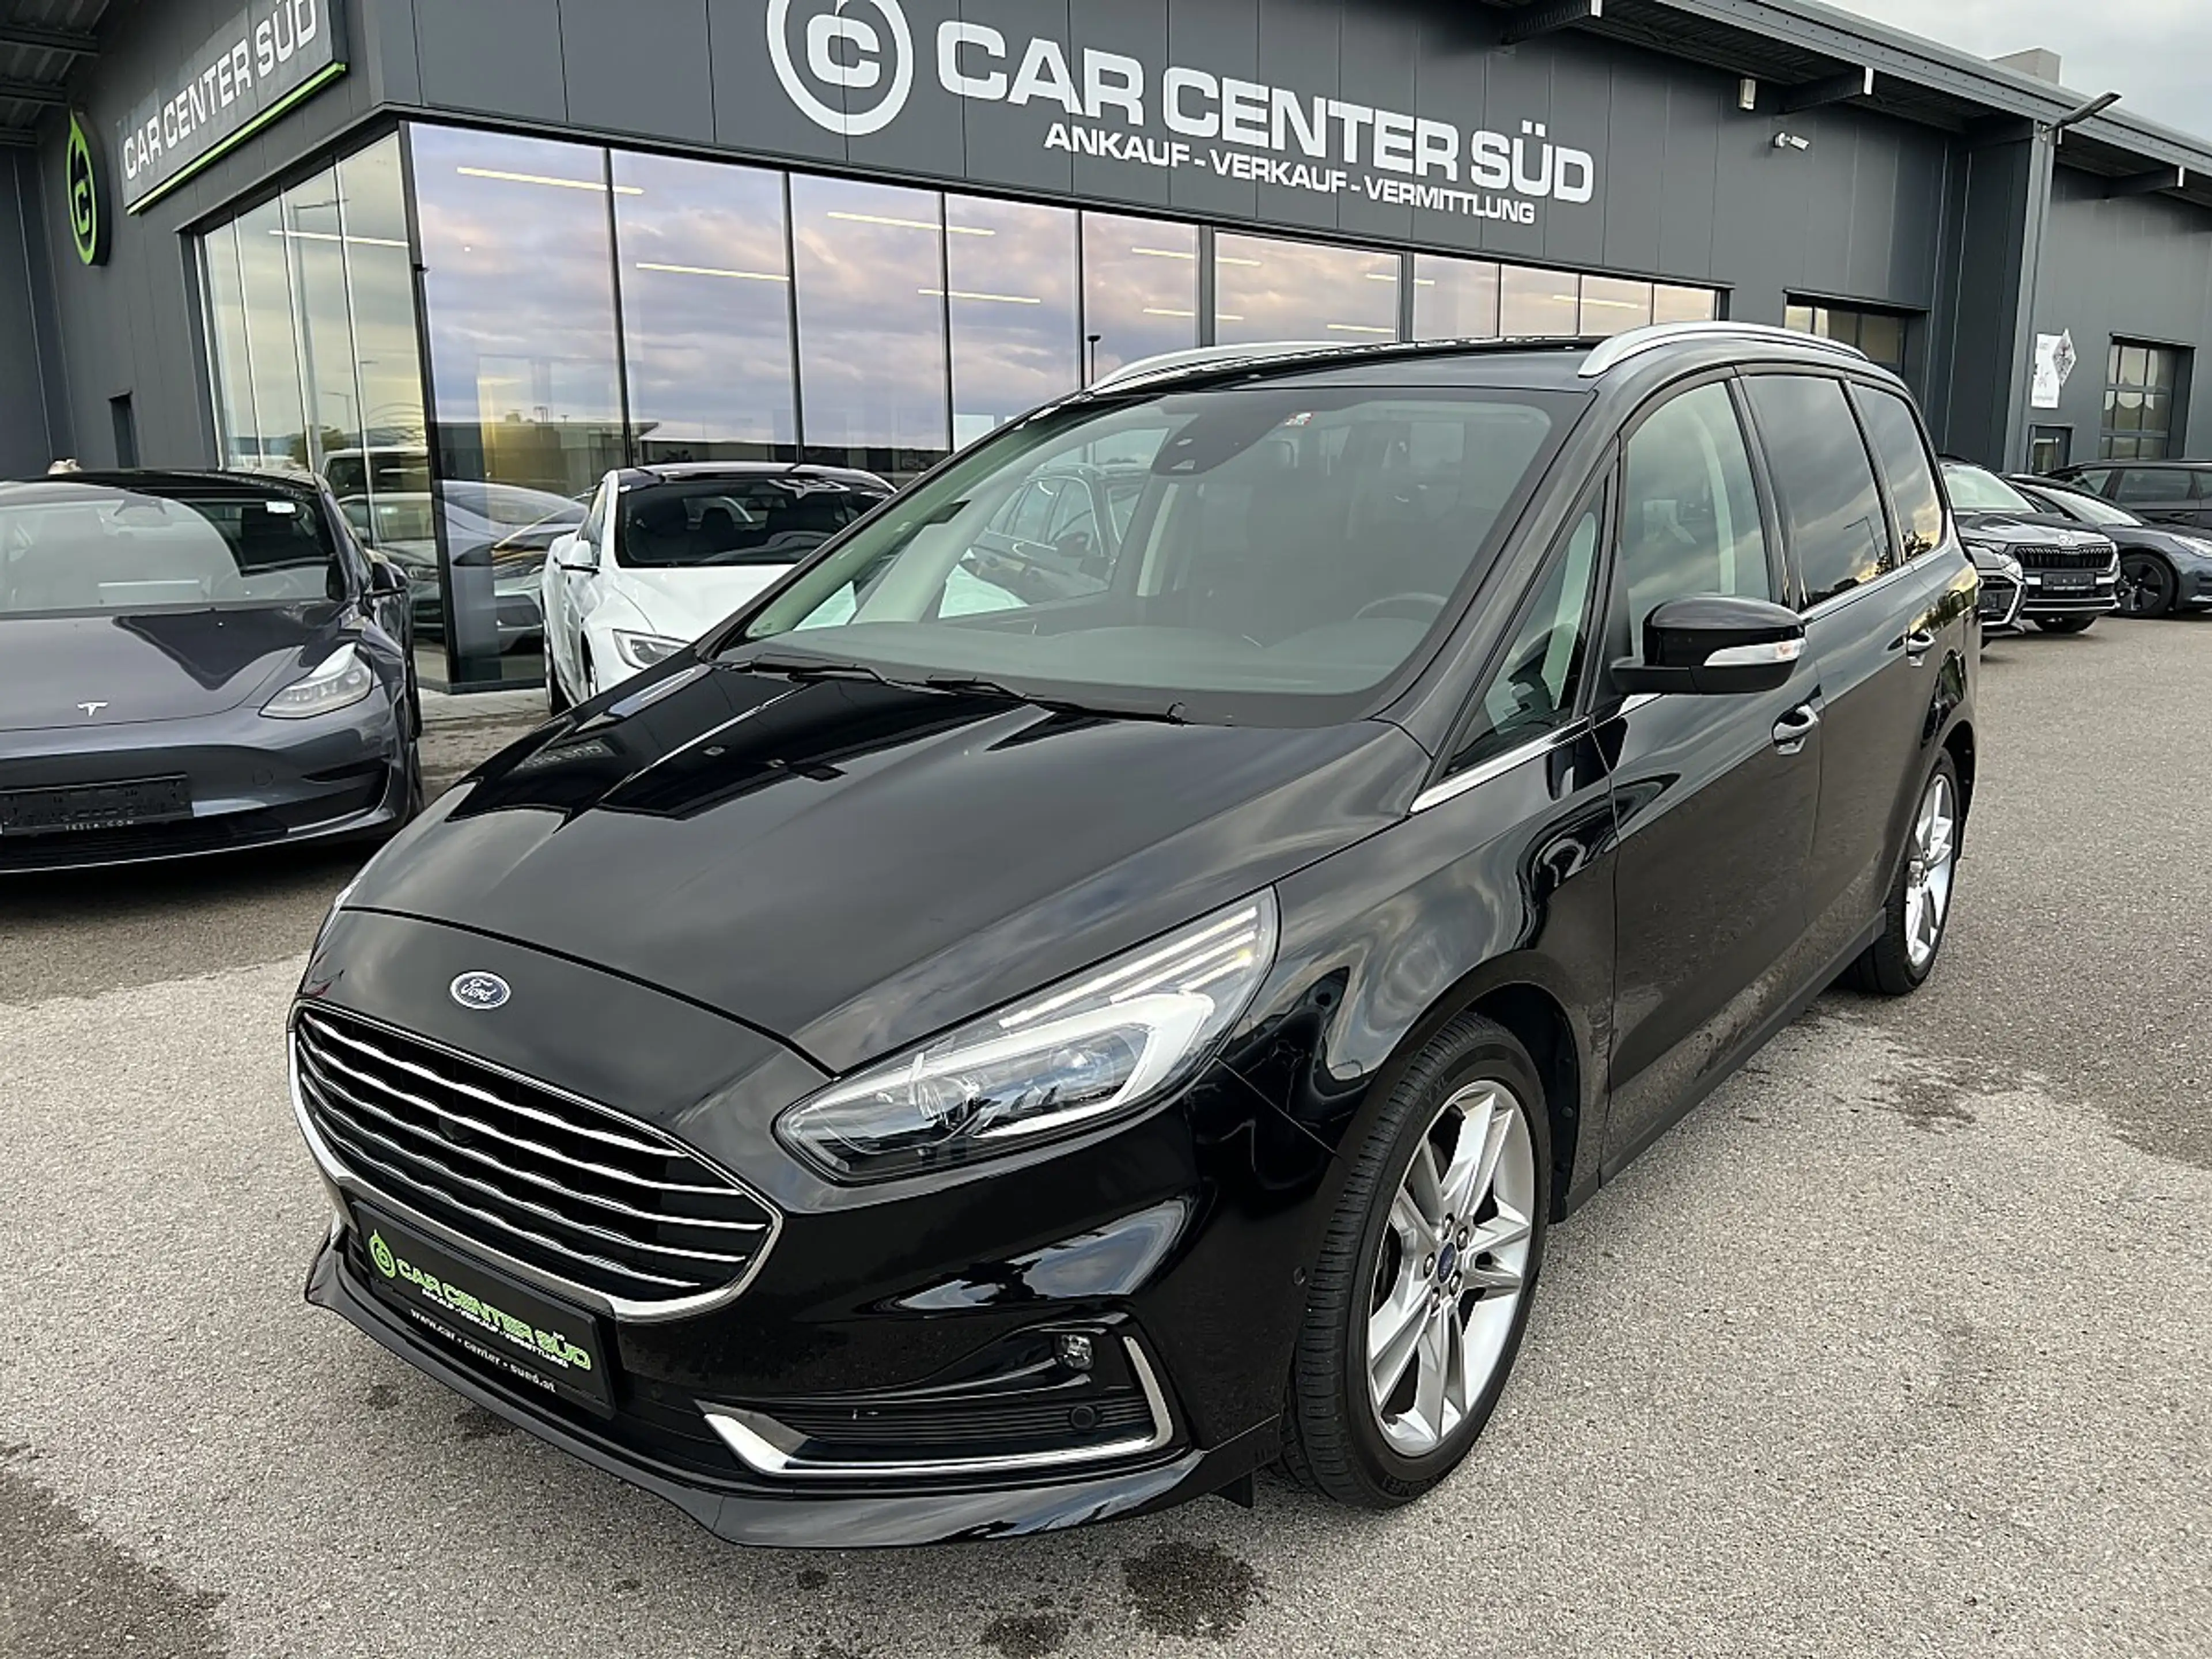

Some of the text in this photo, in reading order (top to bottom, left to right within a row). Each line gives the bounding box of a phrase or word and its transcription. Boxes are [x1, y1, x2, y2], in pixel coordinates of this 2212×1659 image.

[124, 116, 162, 180] CAR
[164, 39, 252, 149] CENTER
[937, 20, 1594, 204] CAR CENTER SÜD
[1043, 123, 1190, 168] ANKAUF
[1210, 149, 1347, 193] VERKAUF
[1363, 175, 1535, 224] VERMITTLUNG
[461, 979, 497, 1001] Ford
[396, 1259, 443, 1297] CAR
